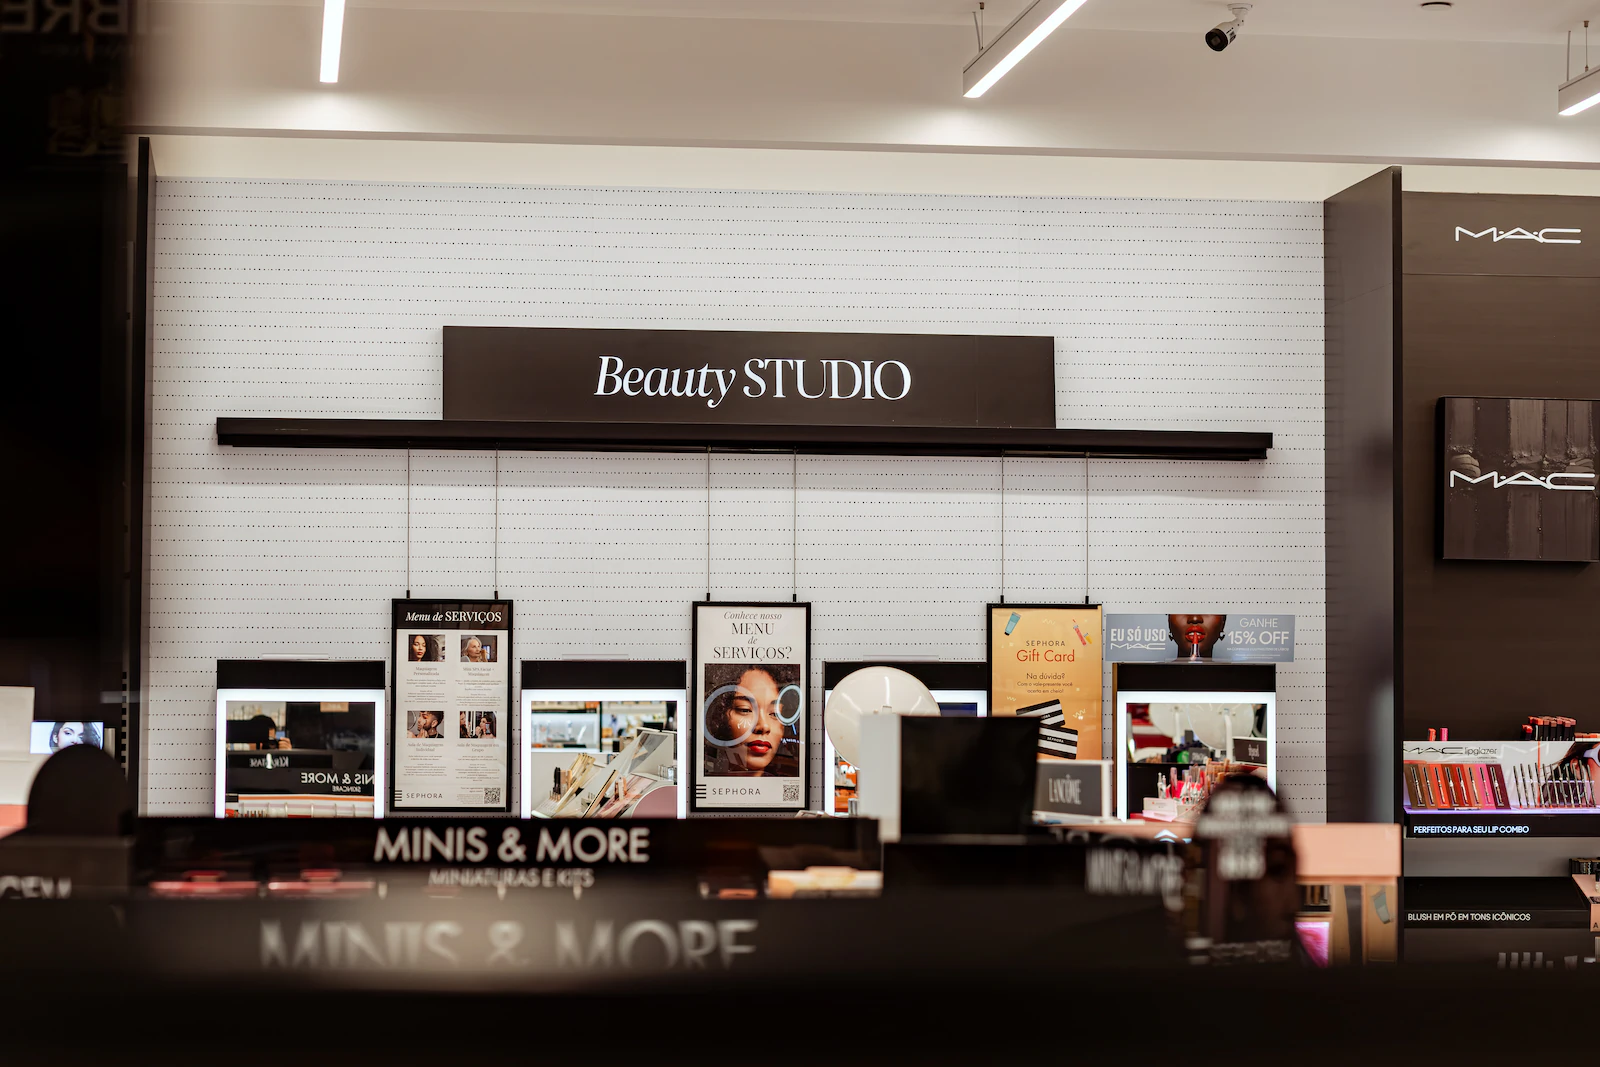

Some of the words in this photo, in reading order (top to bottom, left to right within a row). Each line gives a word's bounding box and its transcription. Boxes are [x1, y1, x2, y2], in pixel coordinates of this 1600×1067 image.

[593, 355, 737, 408] Beauty
[743, 358, 912, 400] STUDIO
[405, 612, 430, 621] Menu
[432, 612, 443, 621] de
[445, 611, 502, 624] SERVIÇOS
[723, 611, 758, 620] Conhece
[731, 623, 775, 635] MENU
[1239, 618, 1278, 628] GANHE
[1110, 628, 1123, 641] EU
[1127, 626, 1141, 641] SÓ
[1144, 628, 1166, 641] USO
[1228, 631, 1257, 645] 15%
[1259, 631, 1290, 645] OFF
[747, 636, 758, 645] de
[713, 646, 792, 661] SERVIÇOS?
[1016, 649, 1040, 662] Gift
[1044, 649, 1075, 662] Card
[1465, 747, 1497, 756] lipglazer
[1413, 825, 1452, 833] PERFEITOS
[1453, 825, 1472, 833] PARA
[1473, 825, 1488, 833] SEU
[1488, 825, 1498, 833] LIP
[1499, 825, 1530, 833] COMBO
[374, 827, 488, 862] MINIS
[497, 828, 528, 862] &
[536, 827, 651, 862] MORE
[428, 868, 540, 887] MINIATURAS
[1407, 913, 1432, 921] BLUSH
[1433, 913, 1444, 921] EM
[1445, 912, 1457, 921] PÓ
[1458, 913, 1469, 921] EM
[1470, 913, 1491, 921] TONS
[1492, 911, 1531, 921] ICÔNICOS
[258, 918, 463, 970] MINIS
[554, 918, 759, 970] MORE
